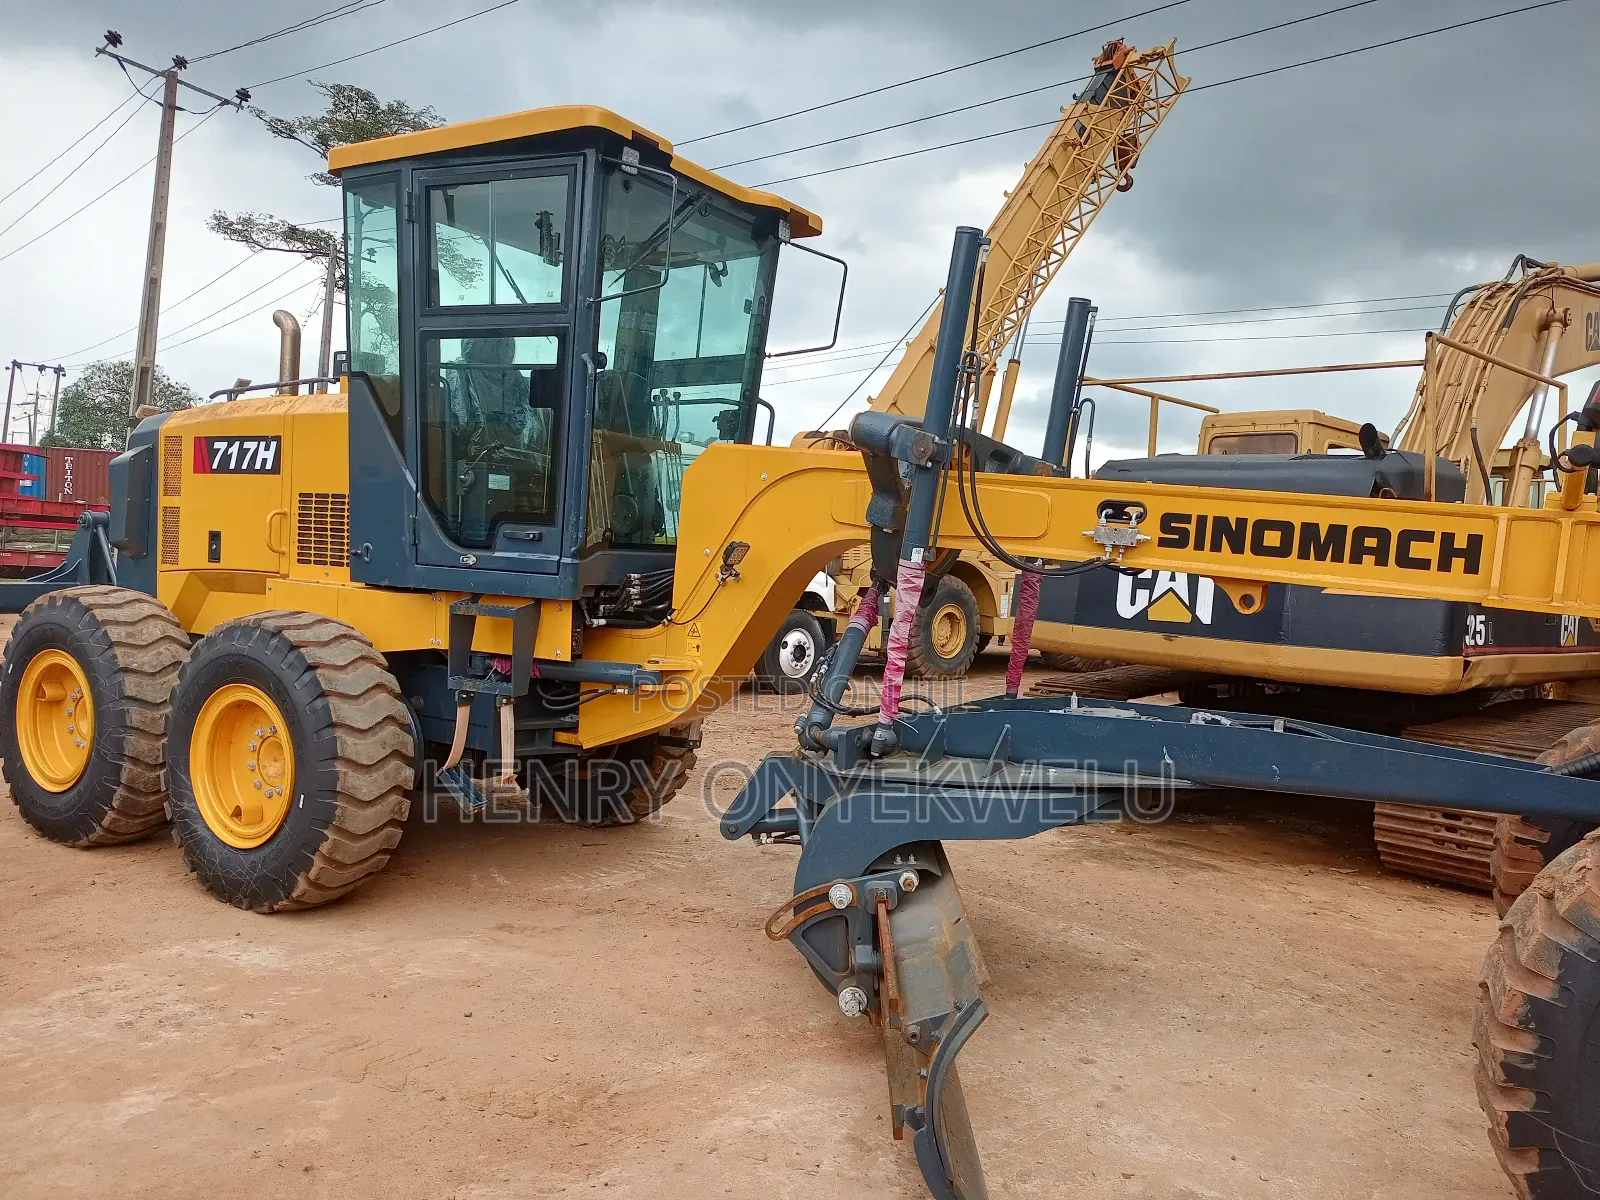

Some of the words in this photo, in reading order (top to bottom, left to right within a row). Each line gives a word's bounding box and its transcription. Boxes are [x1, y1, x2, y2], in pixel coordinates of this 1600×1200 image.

[211, 440, 278, 470] 717H
[64, 456, 74, 495] TRITON
[1157, 511, 1484, 576] SINOMACH
[1116, 568, 1215, 625] CAT
[1560, 614, 1580, 647] CAT
